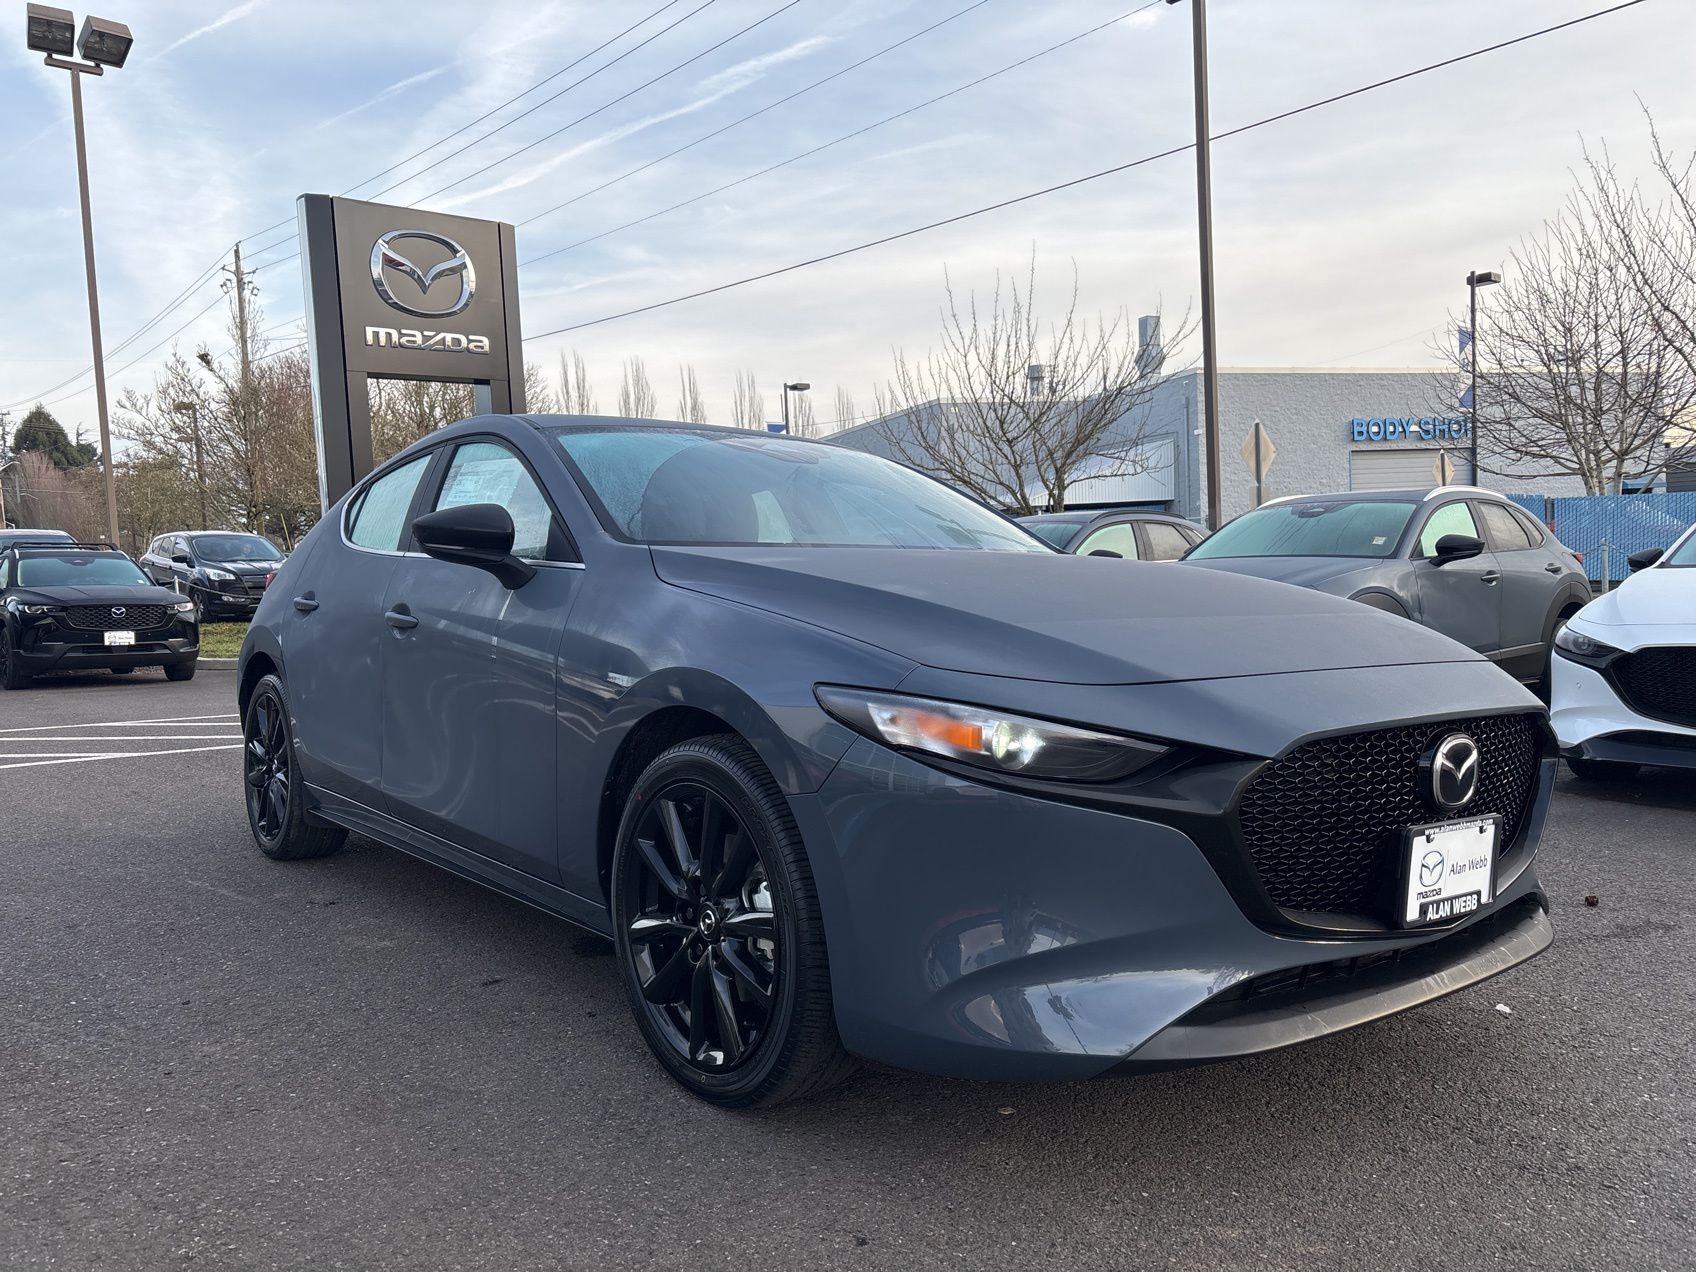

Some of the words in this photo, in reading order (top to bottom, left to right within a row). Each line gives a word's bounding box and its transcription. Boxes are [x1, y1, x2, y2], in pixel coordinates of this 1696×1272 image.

[365, 326, 490, 354] mazda
[1352, 416, 1414, 441] BODY
[1448, 863, 1467, 877] Alan
[1468, 854, 1488, 872] Webb
[1426, 900, 1451, 921] ALAN
[1453, 894, 1478, 914] WEBB
